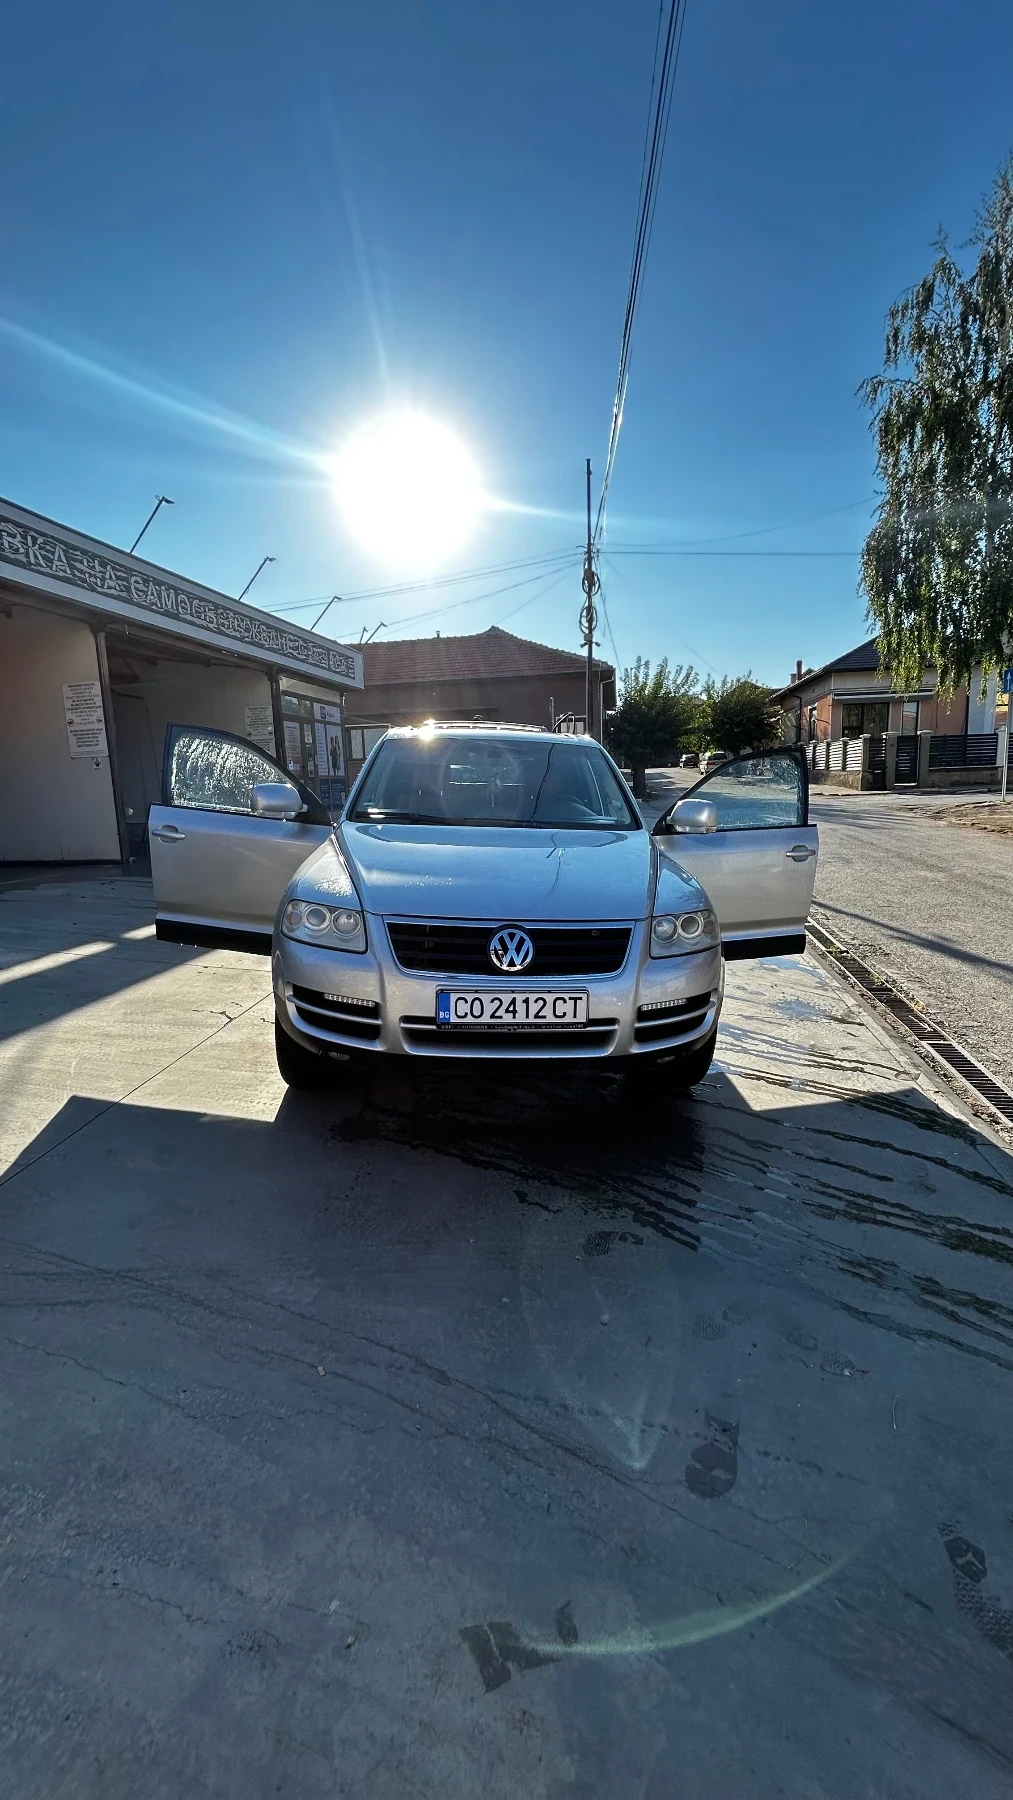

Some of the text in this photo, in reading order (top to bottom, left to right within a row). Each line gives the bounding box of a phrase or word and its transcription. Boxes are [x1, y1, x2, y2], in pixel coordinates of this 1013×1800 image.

[440, 1011, 450, 1019] BG
[454, 996, 583, 1019] CO 2412 CT
